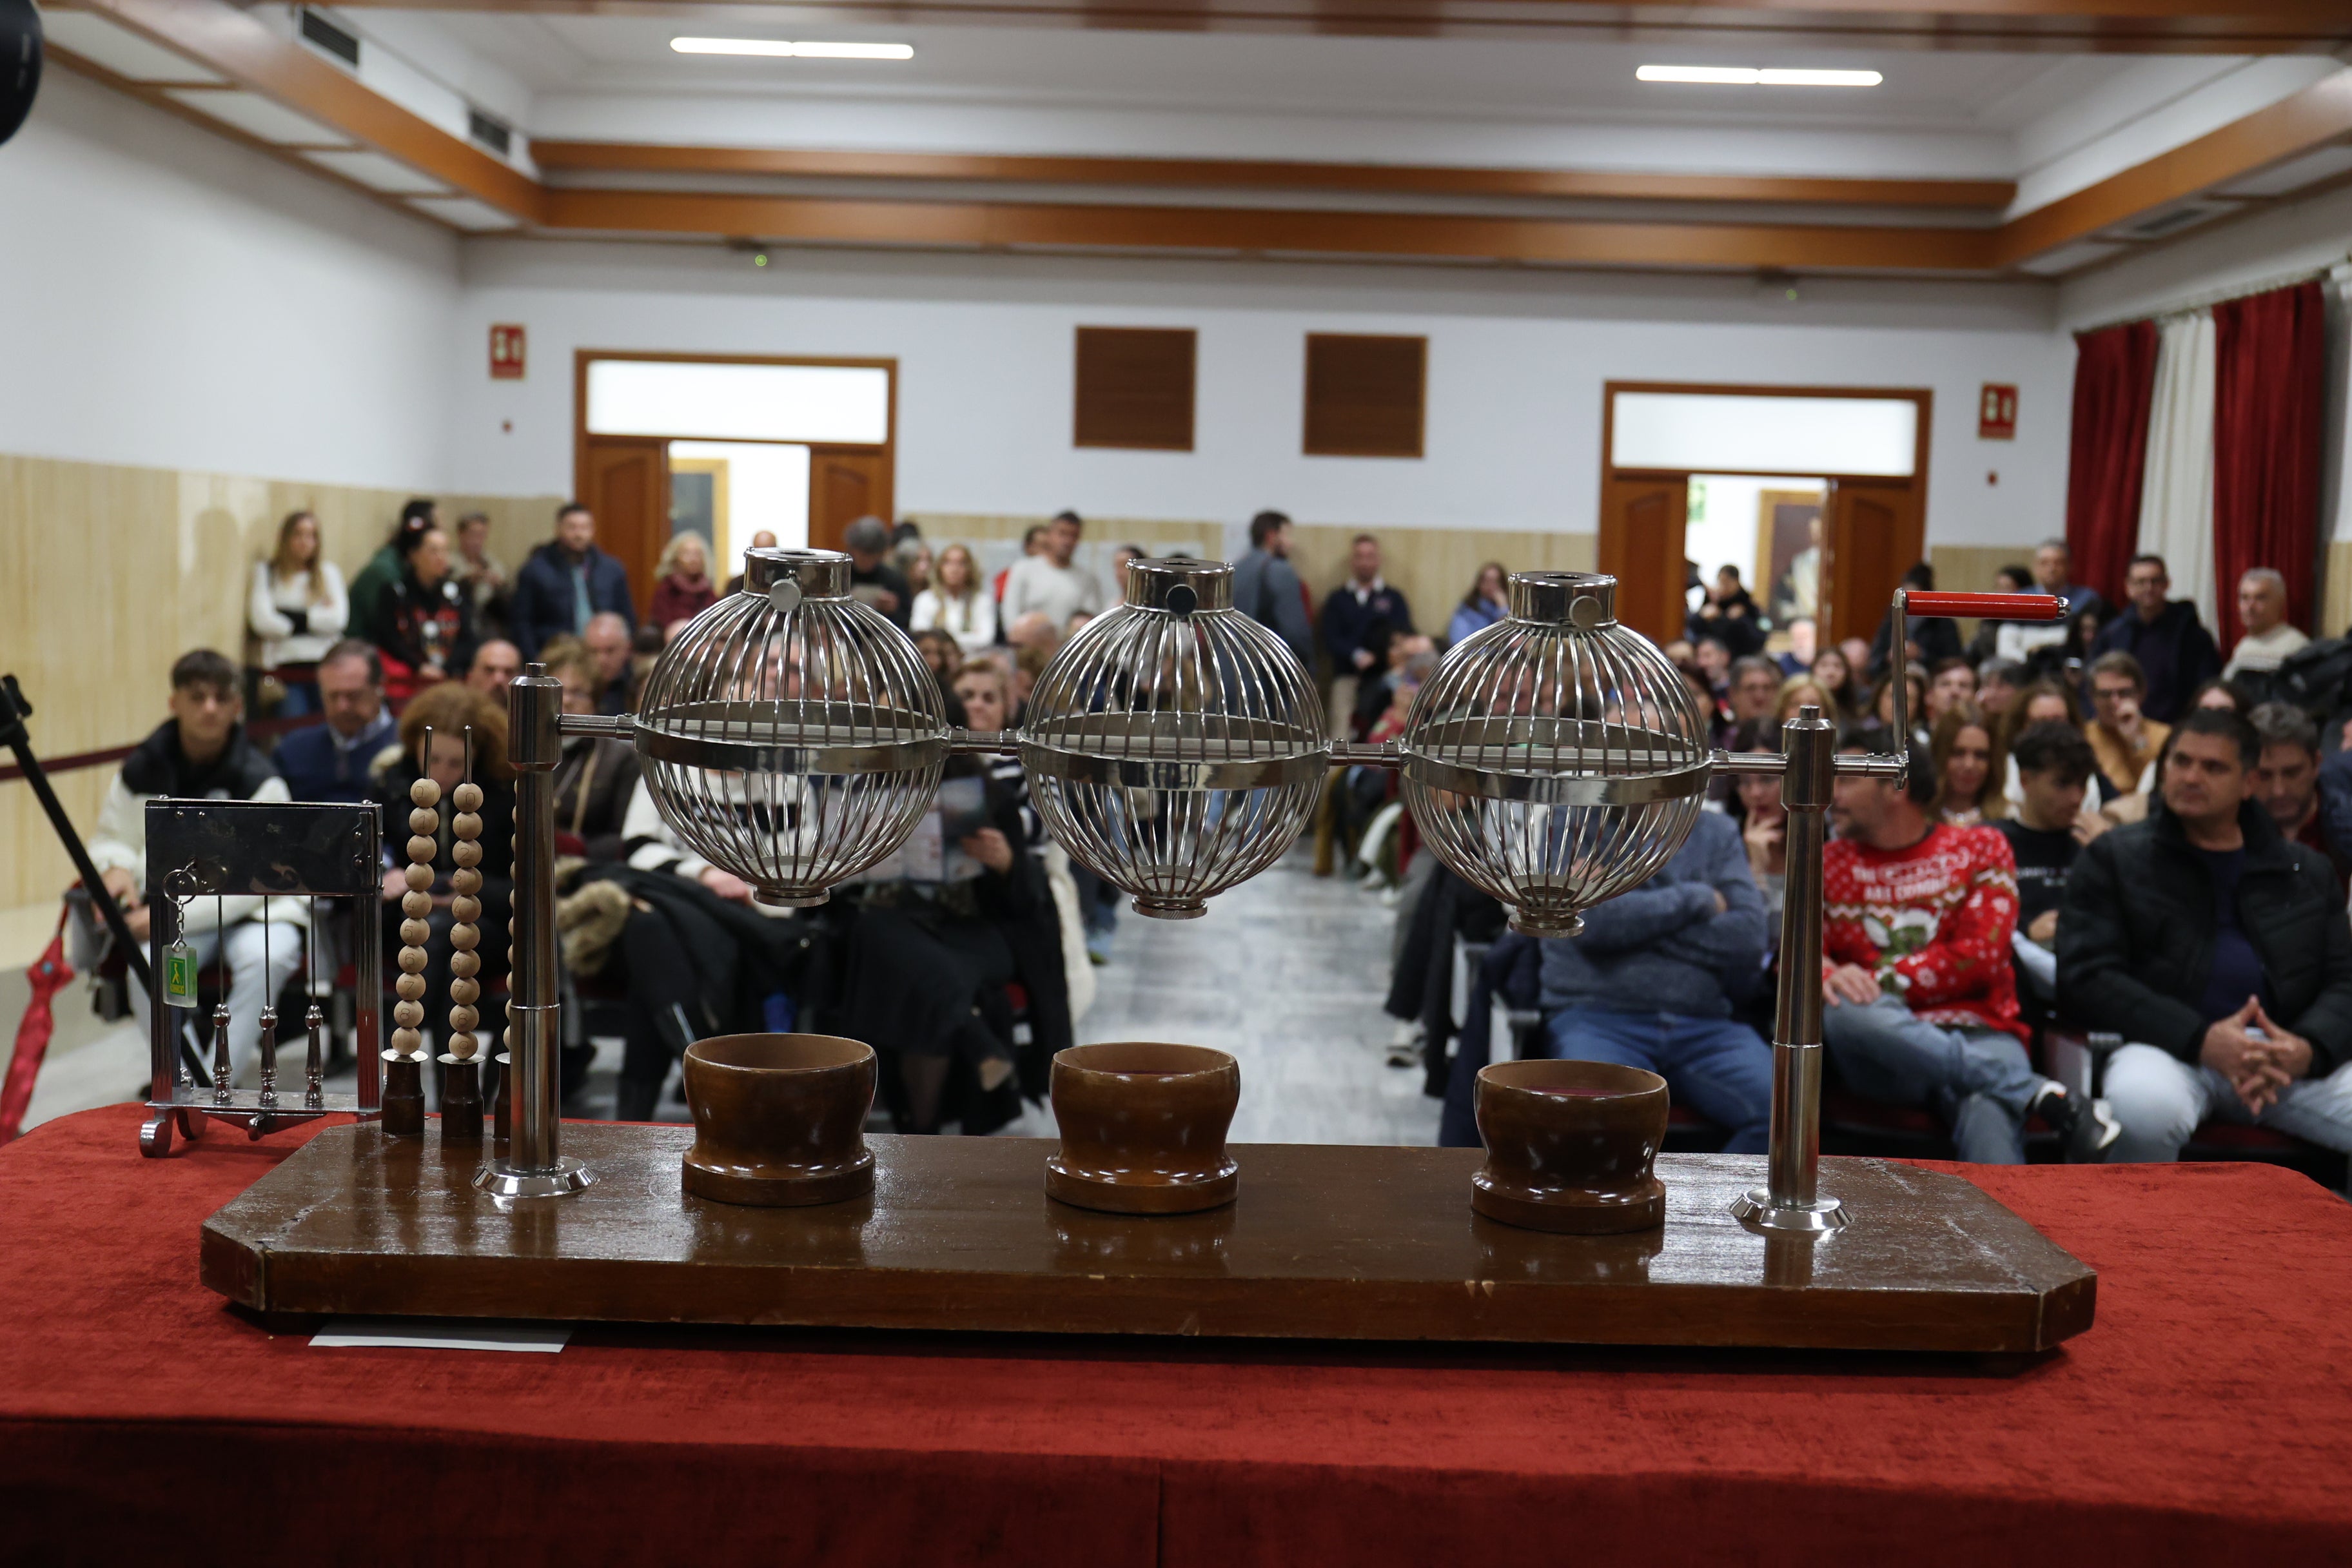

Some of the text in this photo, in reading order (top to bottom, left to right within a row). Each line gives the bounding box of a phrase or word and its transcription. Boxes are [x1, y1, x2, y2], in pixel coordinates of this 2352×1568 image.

[415, 786, 424, 799] 0
[466, 792, 476, 805] 0
[418, 815, 426, 830] 1
[457, 820, 462, 834] 1
[460, 847, 470, 861] 2
[454, 874, 462, 888] 3
[406, 898, 415, 910] 4
[454, 904, 462, 916] 4
[404, 925, 414, 940] 5
[405, 953, 415, 966] 6
[452, 957, 460, 971] 6
[404, 981, 415, 995] 7
[454, 985, 464, 998] 7
[400, 1008, 411, 1021] 8
[458, 1013, 468, 1025] 8
[458, 1041, 469, 1055] 9
